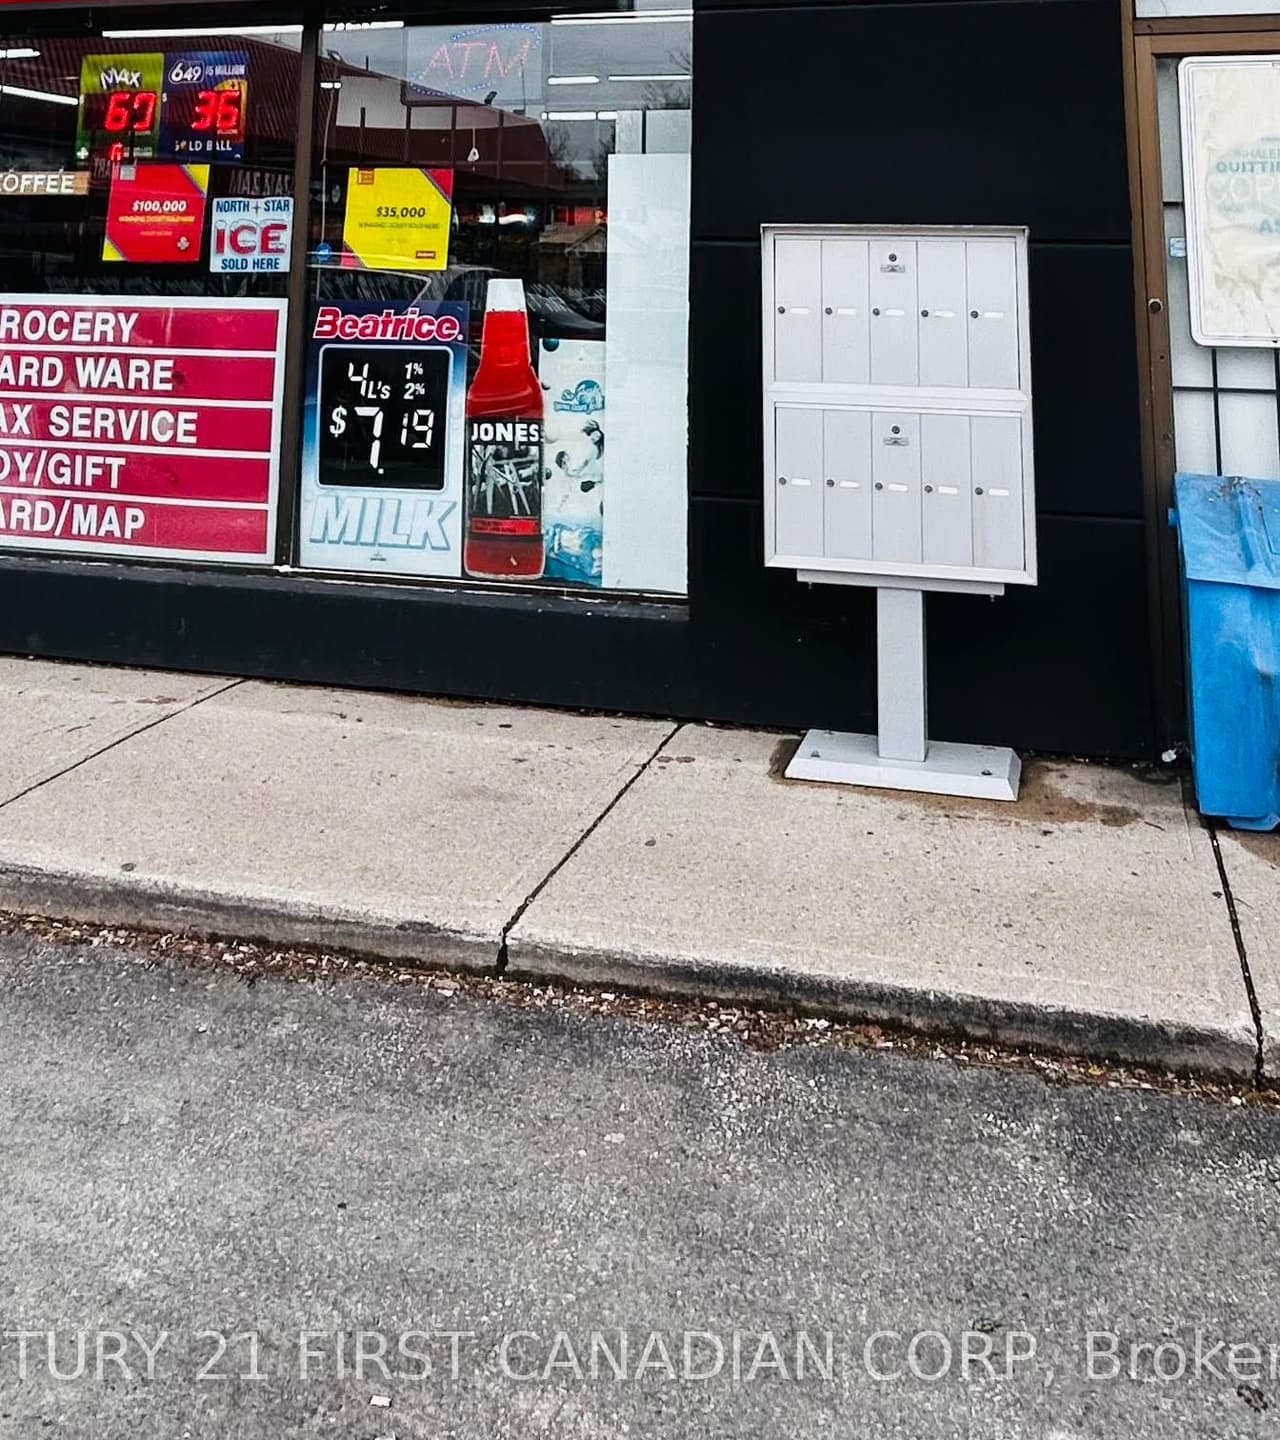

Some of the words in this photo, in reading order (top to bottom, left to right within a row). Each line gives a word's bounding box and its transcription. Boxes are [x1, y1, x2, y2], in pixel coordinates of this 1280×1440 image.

[428, 38, 531, 80] ATM
[100, 68, 142, 90] MAX
[191, 91, 241, 131] 36
[132, 200, 187, 214] $100,000
[216, 200, 250, 212] NORTH
[264, 199, 291, 212] STAR
[376, 206, 426, 219] $35,000
[221, 258, 248, 271] SOLD
[252, 258, 280, 270] HERE
[313, 306, 463, 341] Beatrice
[75, 357, 175, 391] WARE
[404, 363, 424, 380] 1%
[403, 382, 426, 401] 2%
[48, 406, 199, 444] SERVICE
[471, 422, 540, 442] JONES
[309, 494, 458, 552] MILK
